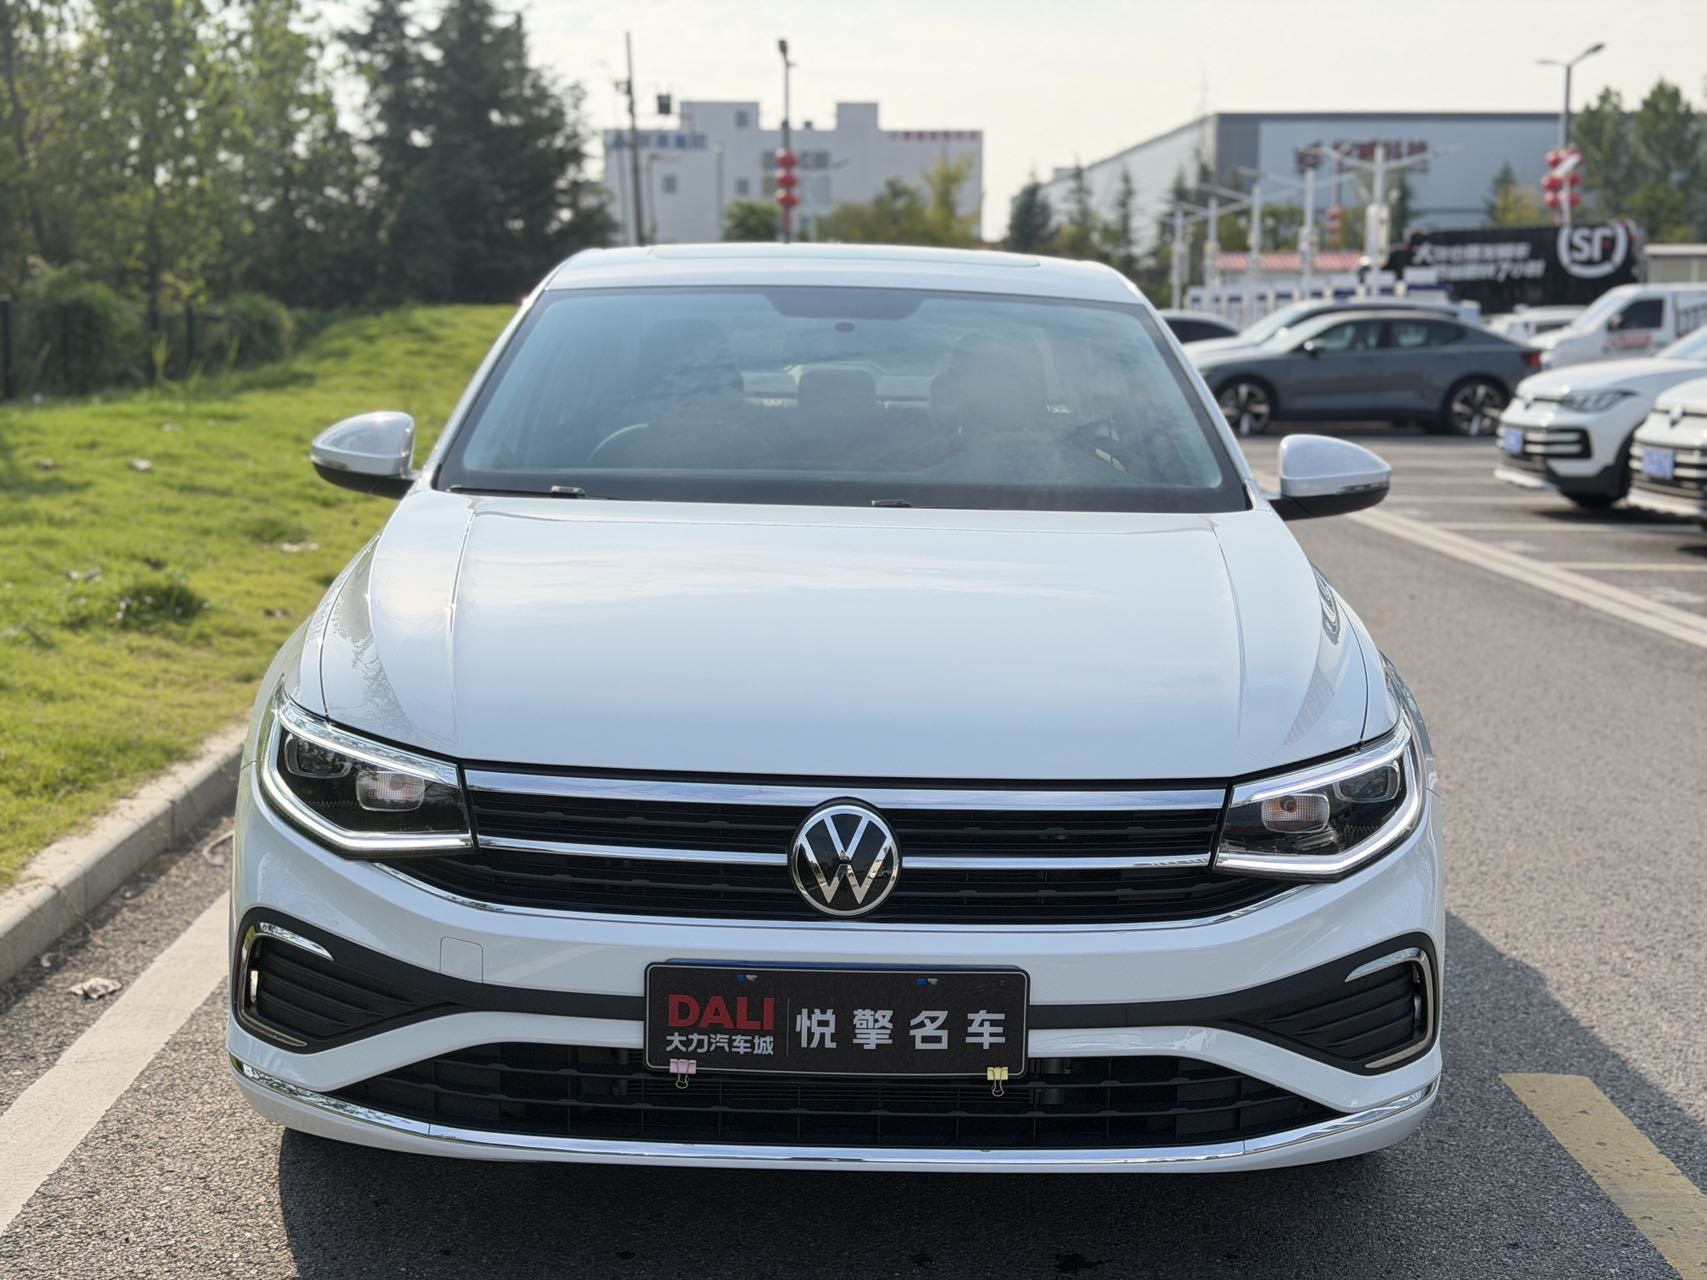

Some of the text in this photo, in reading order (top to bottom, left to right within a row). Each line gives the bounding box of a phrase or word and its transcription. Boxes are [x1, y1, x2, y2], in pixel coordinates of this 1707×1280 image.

[667, 994, 776, 1031] DALI
[795, 1007, 1006, 1050] 悦擎名车
[665, 1032, 775, 1056] 大力汽车城
